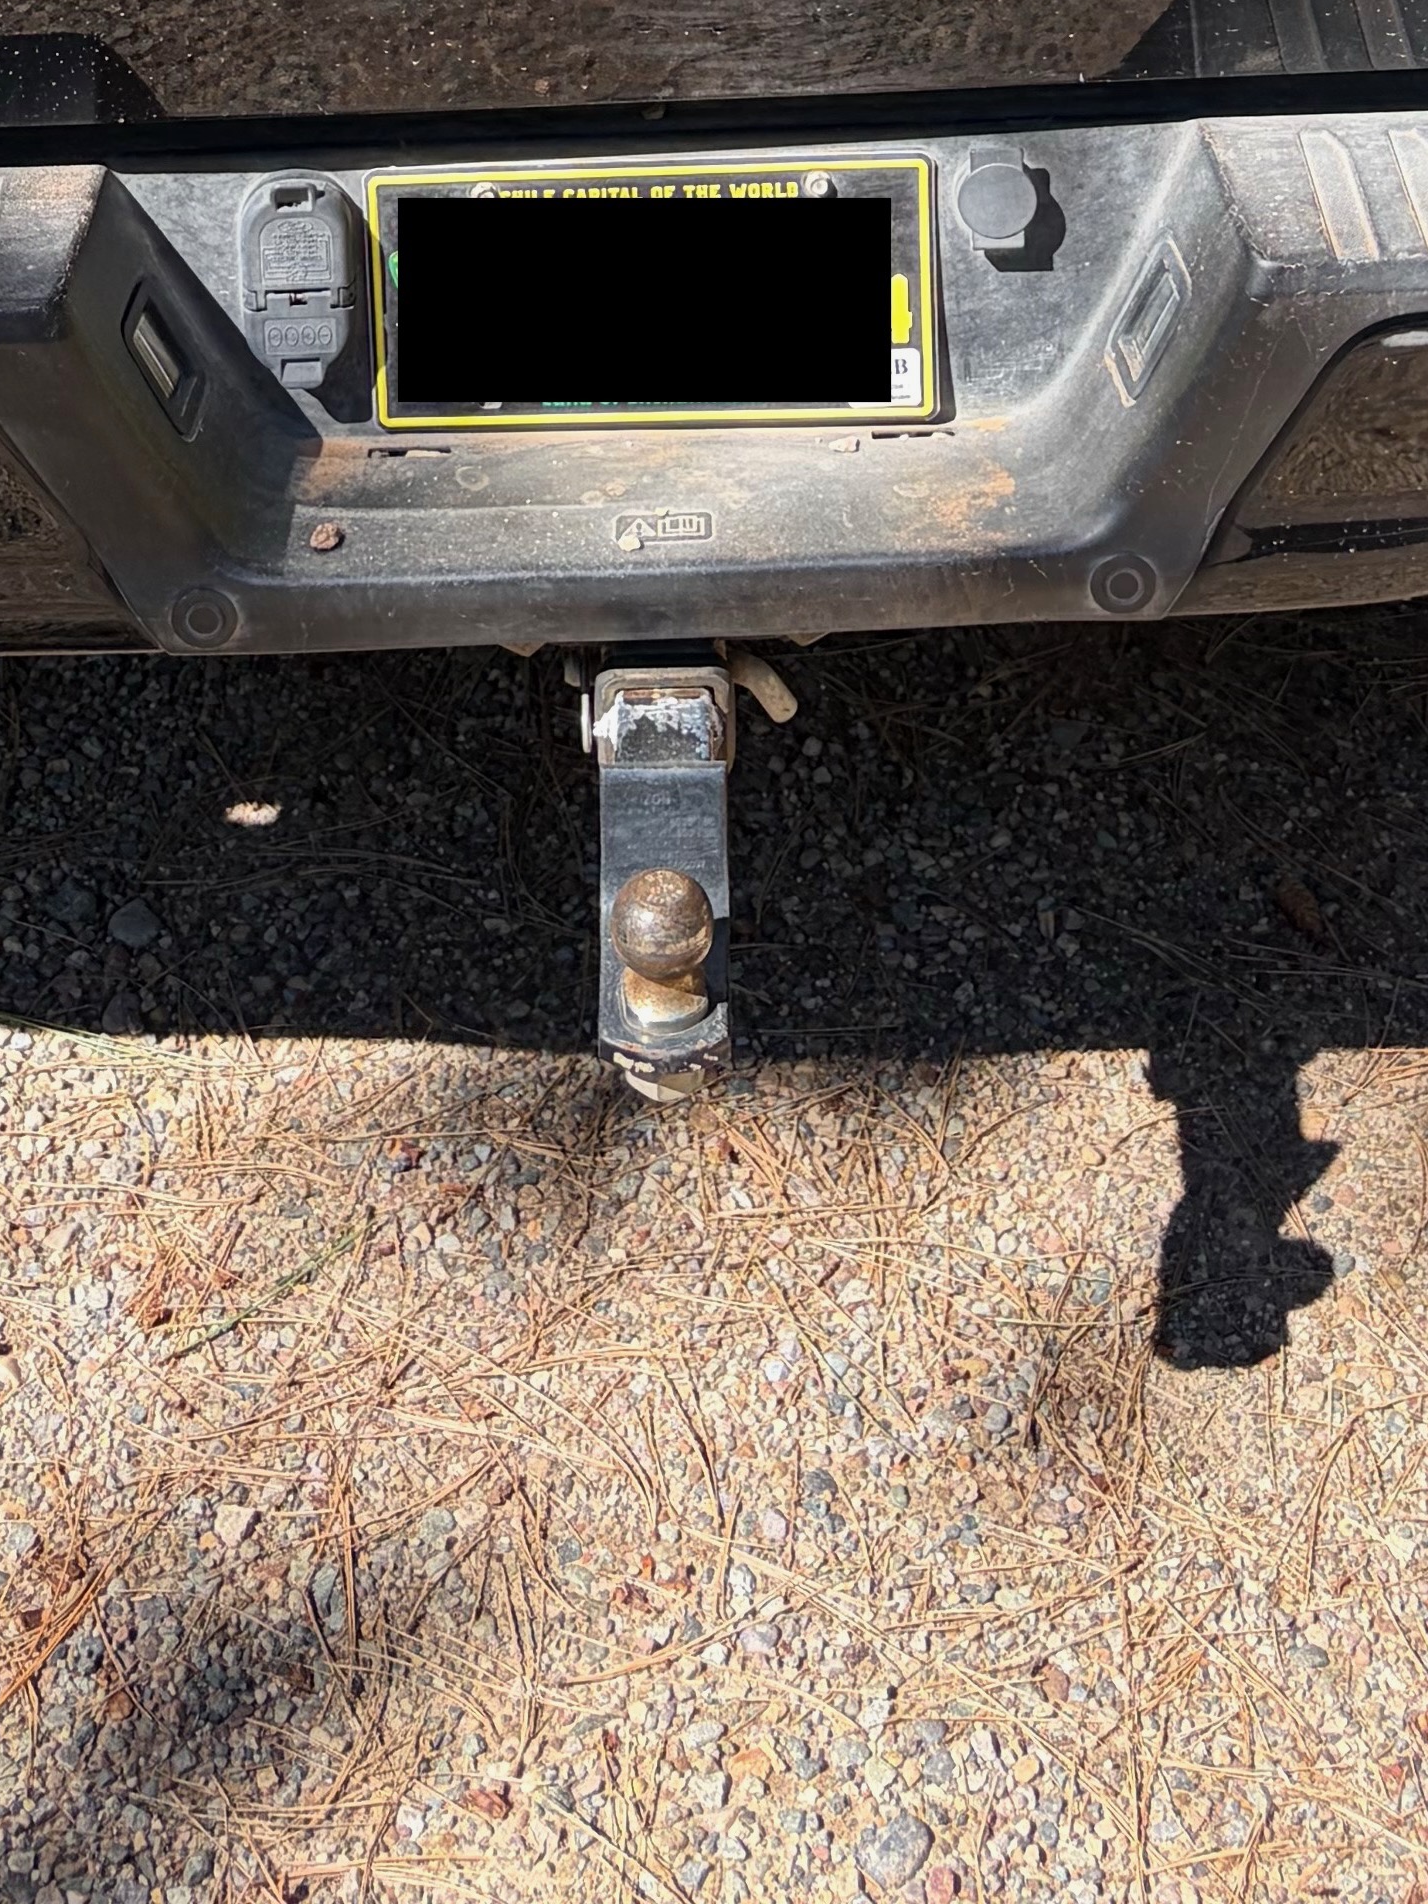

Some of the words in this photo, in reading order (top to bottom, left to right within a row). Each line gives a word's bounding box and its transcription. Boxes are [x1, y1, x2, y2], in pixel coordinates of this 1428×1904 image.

[650, 185, 676, 199] OF
[683, 184, 722, 199] THE
[728, 181, 799, 199] WORLD
